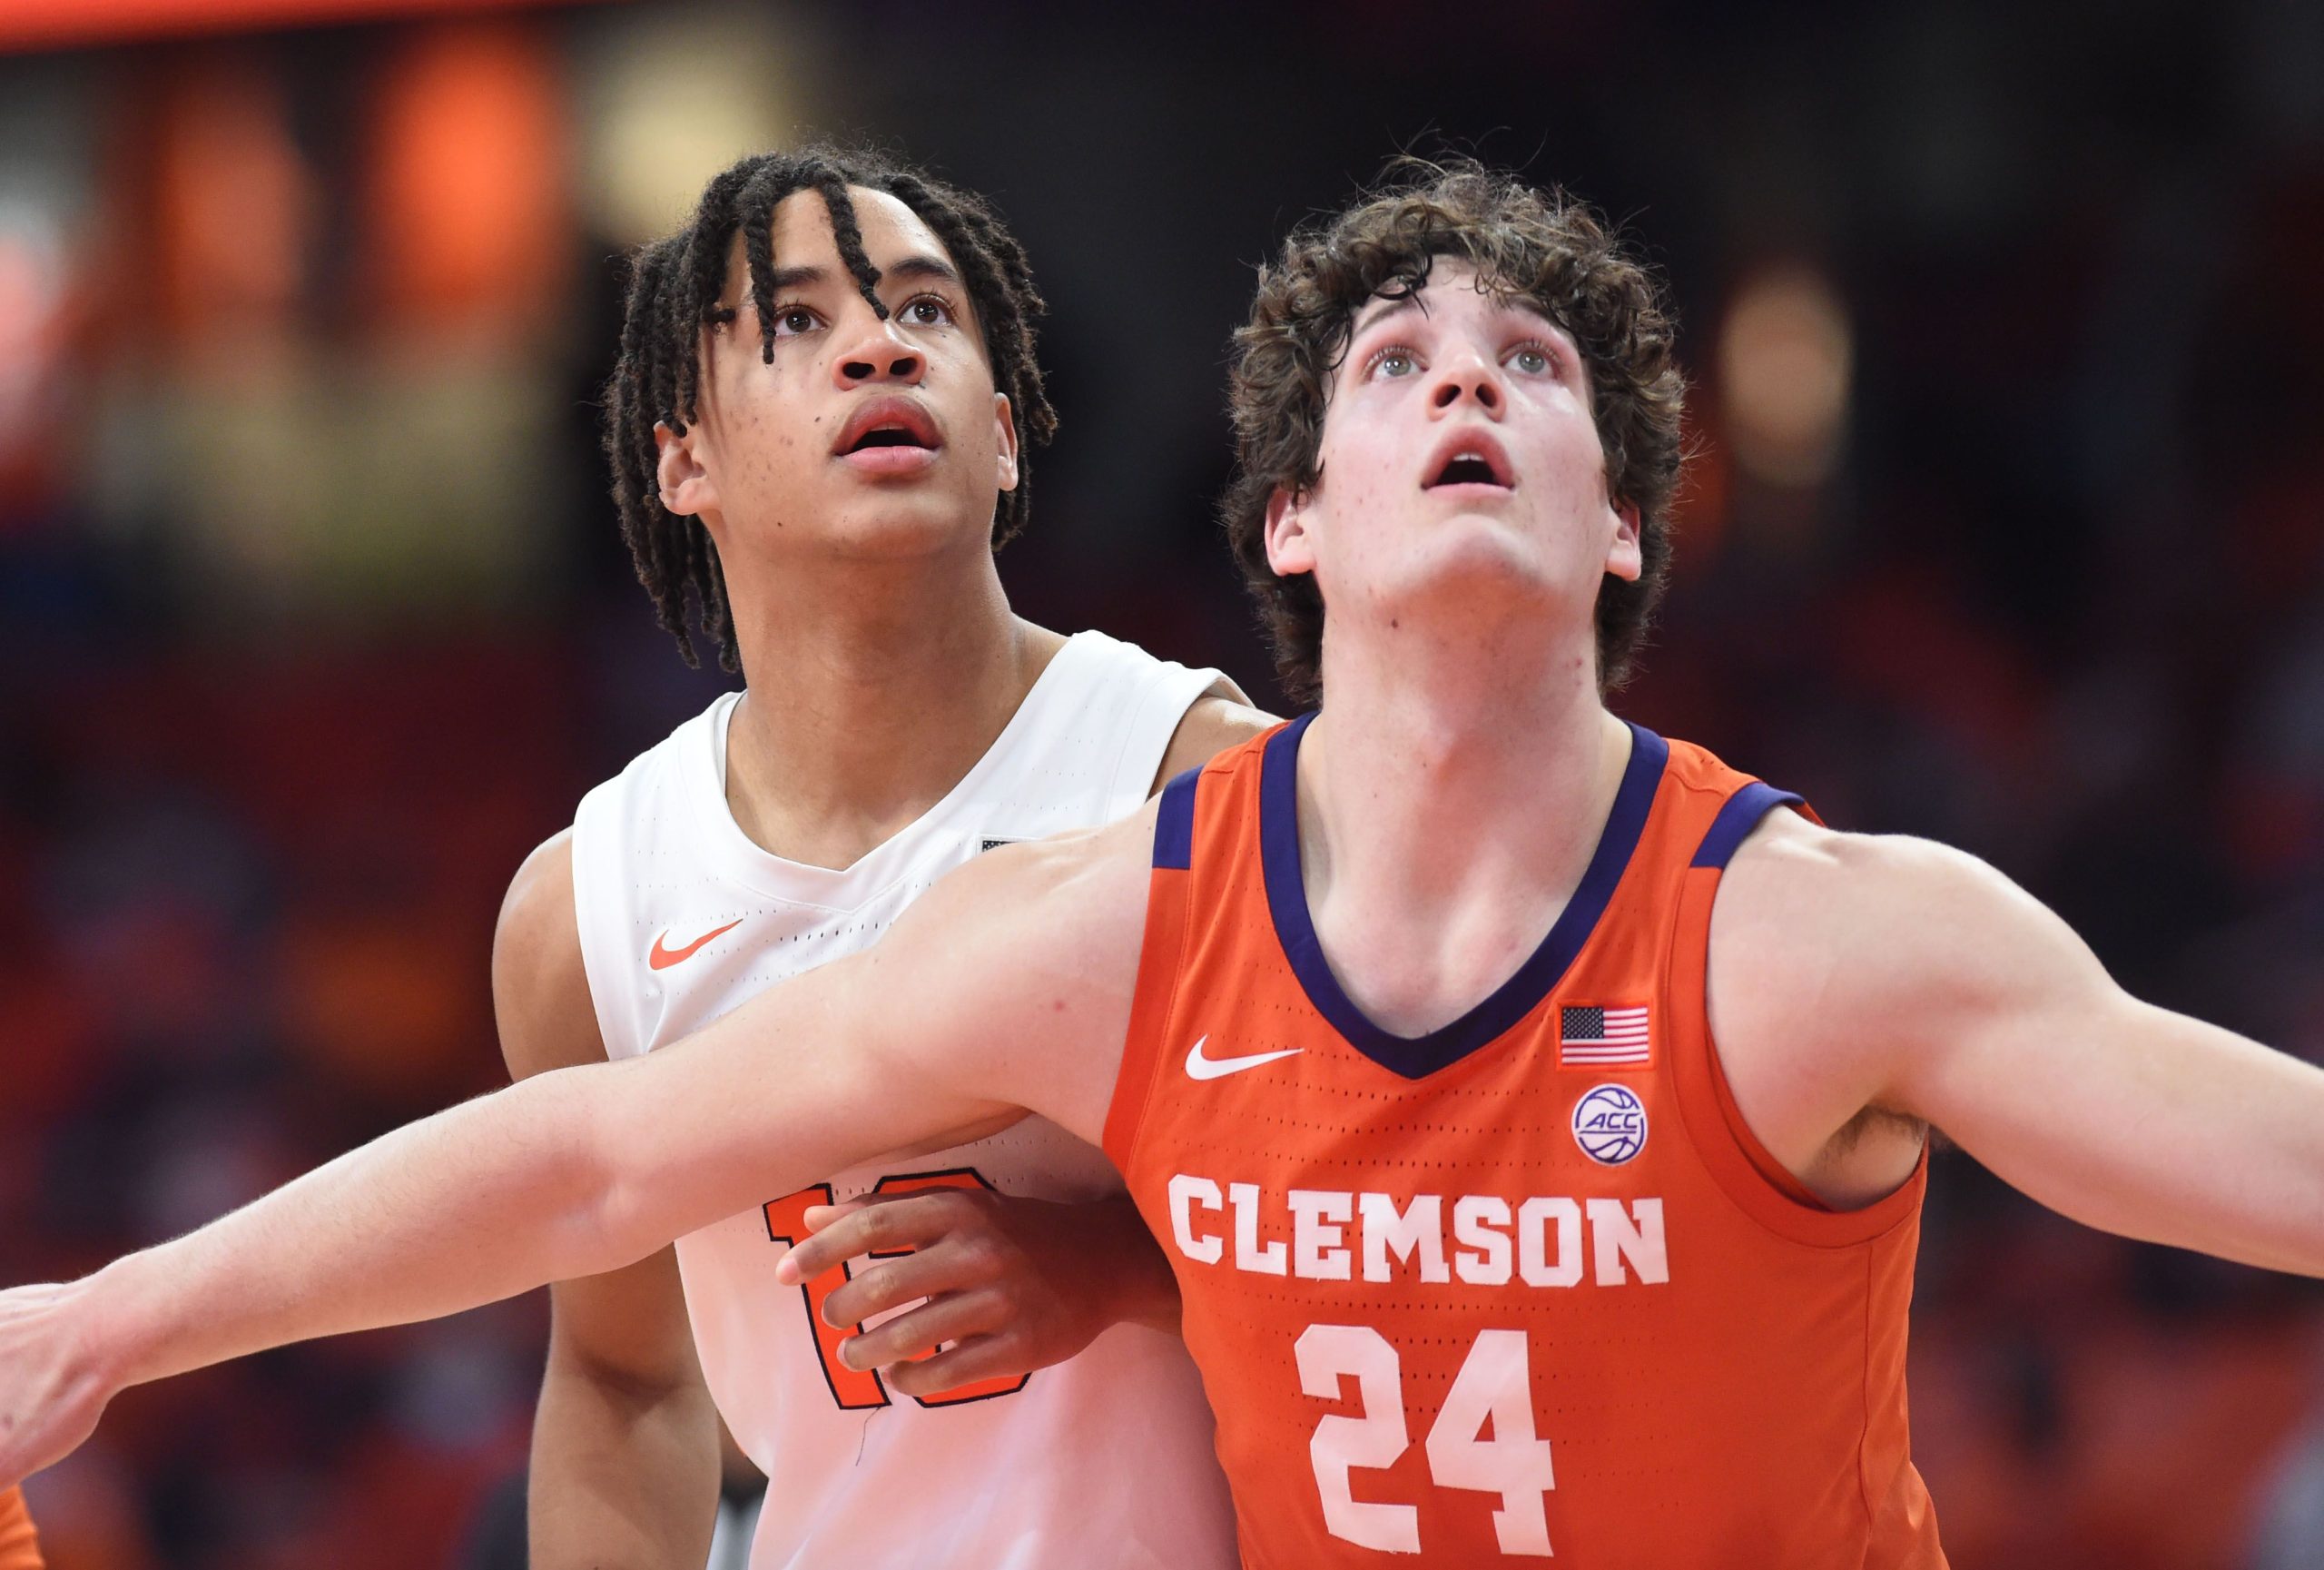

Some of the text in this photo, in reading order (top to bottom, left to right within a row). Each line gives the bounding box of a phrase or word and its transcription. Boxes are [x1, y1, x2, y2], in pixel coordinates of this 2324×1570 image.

[1585, 1112, 1640, 1129] ACC
[1168, 1174, 1669, 1287] CLEMSON
[1294, 1324, 1555, 1556] 24
